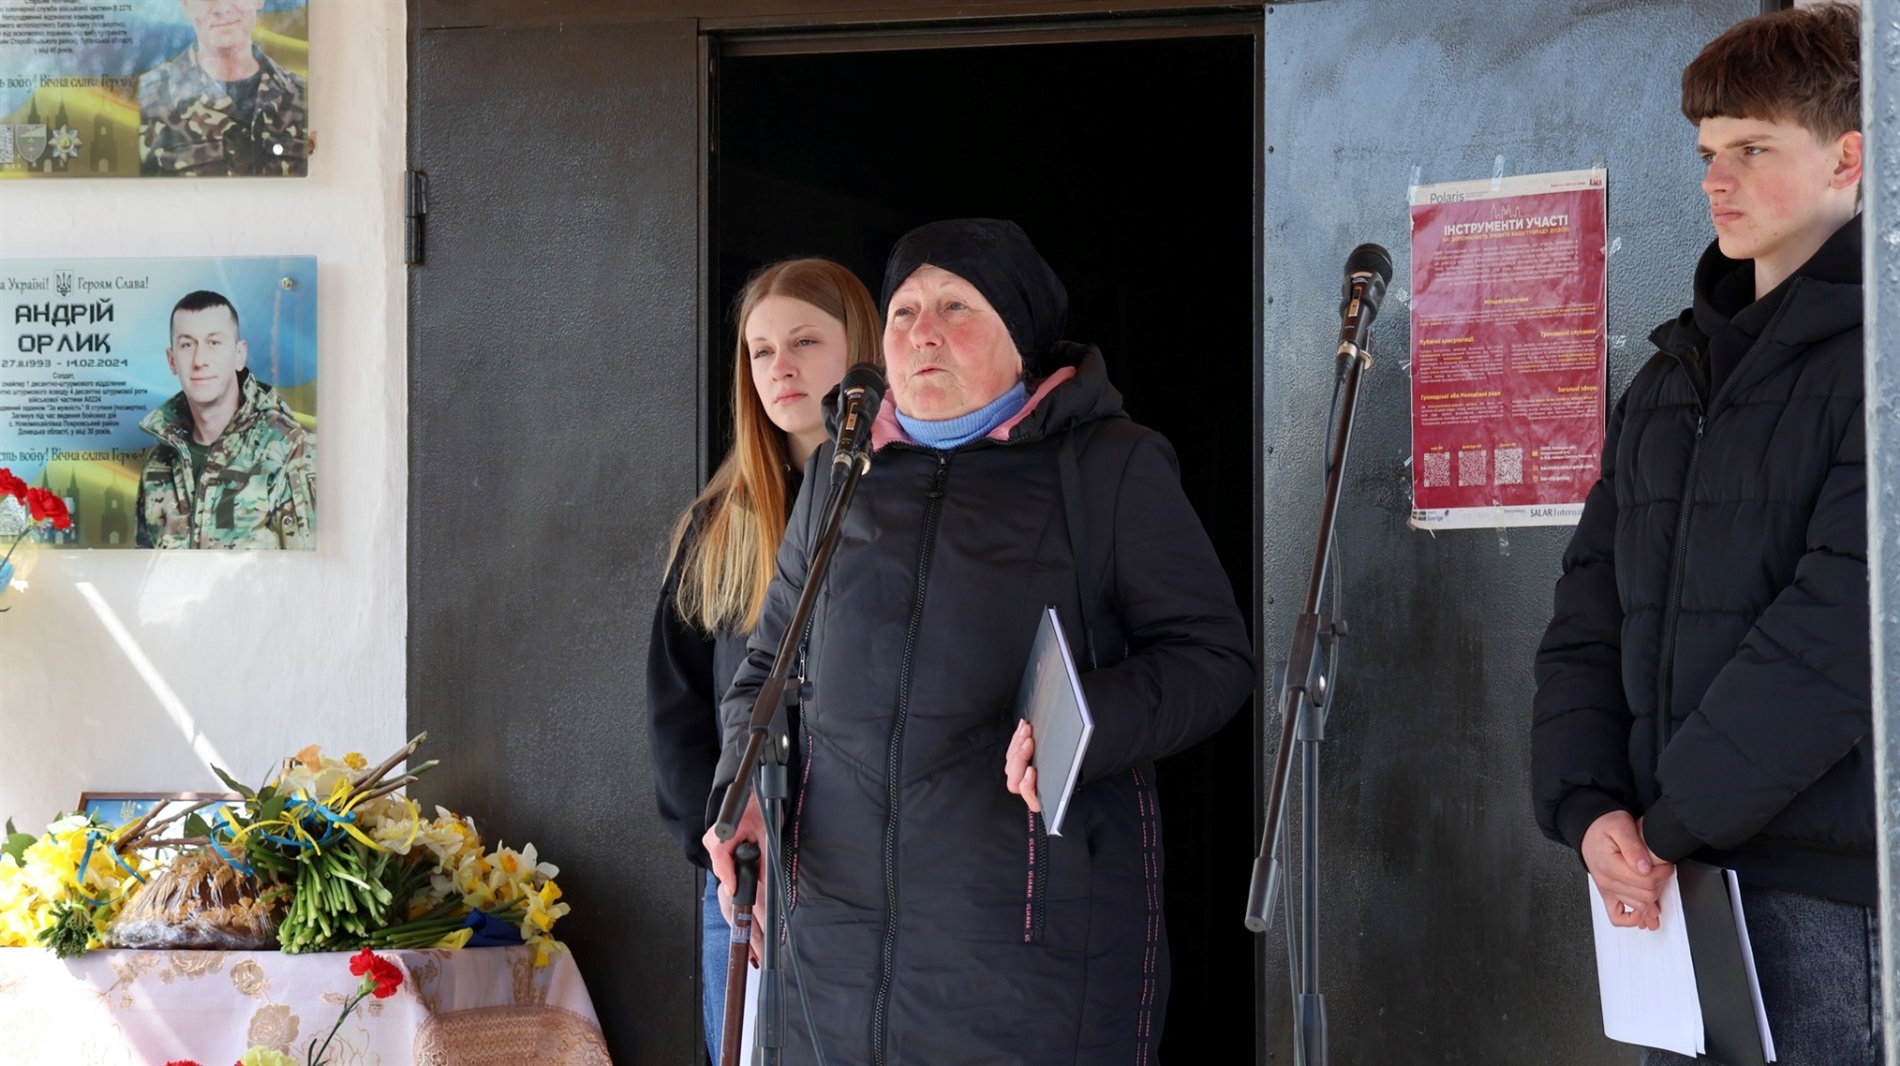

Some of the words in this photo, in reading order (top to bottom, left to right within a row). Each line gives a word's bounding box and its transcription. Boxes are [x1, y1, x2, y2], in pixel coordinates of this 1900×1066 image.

[40, 73, 69, 88] Вічна
[1430, 190, 1465, 204] Polaris
[1443, 219, 1523, 236] ІНСТРУМЕНТИ
[1526, 214, 1568, 230] УЧАСТІ
[8, 277, 49, 294] Україні!
[78, 277, 112, 294] Героям
[115, 276, 149, 290] Слава!
[15, 298, 114, 327] АНДРІЙ
[18, 331, 111, 354] ОРЛИК
[66, 359, 128, 367] 14.02.2024
[51, 447, 80, 461] Вічна
[81, 450, 110, 461] слава
[1530, 508, 1552, 518] SALAR
